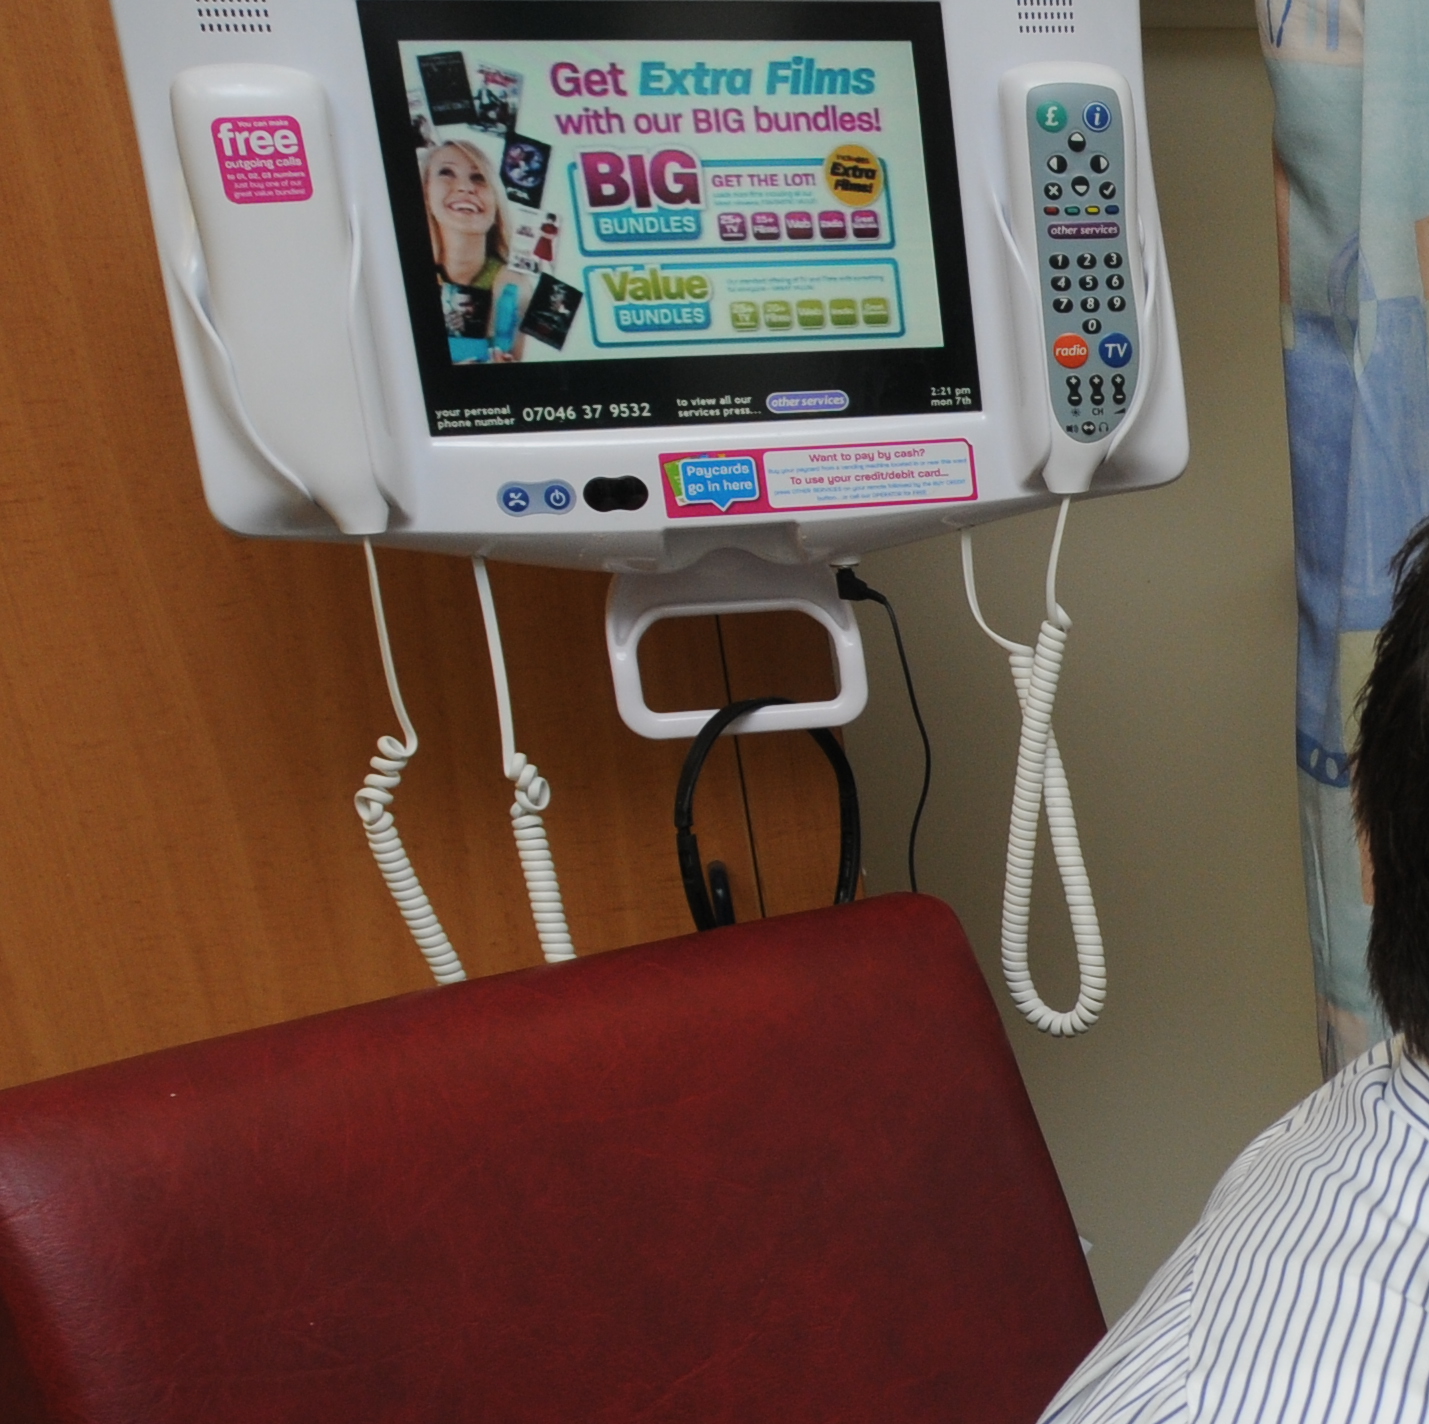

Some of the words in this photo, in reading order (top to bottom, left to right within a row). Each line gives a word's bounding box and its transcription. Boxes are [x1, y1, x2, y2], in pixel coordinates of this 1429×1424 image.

[550, 61, 628, 97] Get
[638, 61, 752, 96] Extra
[766, 57, 876, 95] Films
[554, 107, 625, 135] with
[634, 112, 682, 135] our
[693, 107, 745, 133] BIG
[755, 105, 882, 133] bundles!
[1044, 105, 1059, 127] £
[217, 122, 299, 156] free
[225, 157, 274, 171] outgoing
[275, 156, 302, 167] calls
[830, 163, 877, 178] Extra
[579, 148, 701, 208] BIG
[711, 174, 743, 188] GET
[747, 174, 779, 187] THE
[784, 173, 817, 187] LOT!
[834, 178, 874, 194] Films!
[600, 215, 696, 235] BUNDLES
[1050, 225, 1078, 235] other
[1080, 224, 1119, 235] services
[1057, 255, 1063, 266] 1
[1083, 254, 1091, 266] 2
[1109, 253, 1117, 265] 3
[602, 263, 709, 301] Value
[1057, 276, 1066, 288] 4
[1085, 276, 1093, 288] 5
[1111, 275, 1120, 287] 6
[1060, 298, 1068, 310] 7
[1086, 297, 1095, 310] 8
[1113, 297, 1121, 309] 9
[619, 307, 705, 326] BUNDLES
[1088, 320, 1097, 331] 0
[1055, 344, 1087, 356] radio
[1104, 343, 1128, 359] TV
[930, 386, 952, 396] 2:21
[955, 387, 972, 397] pm
[676, 397, 688, 406] to
[690, 396, 717, 406] view
[719, 395, 733, 405] all
[735, 396, 752, 405] our
[771, 394, 800, 408] other
[801, 395, 845, 407] services
[930, 397, 953, 407] mon
[955, 396, 972, 406] 7th
[435, 408, 461, 420] your
[464, 405, 511, 417] personal
[522, 406, 577, 422] 07046
[582, 404, 603, 419] 37
[609, 402, 652, 418] 9532
[678, 407, 721, 418] services
[1091, 407, 1104, 416] CH
[437, 418, 472, 431] phone
[474, 417, 515, 427] number
[808, 454, 838, 463] Want
[840, 453, 852, 461] to
[854, 452, 875, 462] pay
[877, 450, 892, 460] by
[894, 448, 926, 459] cash?
[686, 462, 750, 479] Paycards
[789, 476, 802, 485] To
[805, 475, 825, 484] use
[827, 474, 851, 485] your
[854, 469, 915, 483] credit/debit
[687, 483, 705, 496] go
[707, 480, 720, 492] in
[723, 479, 753, 491] here
